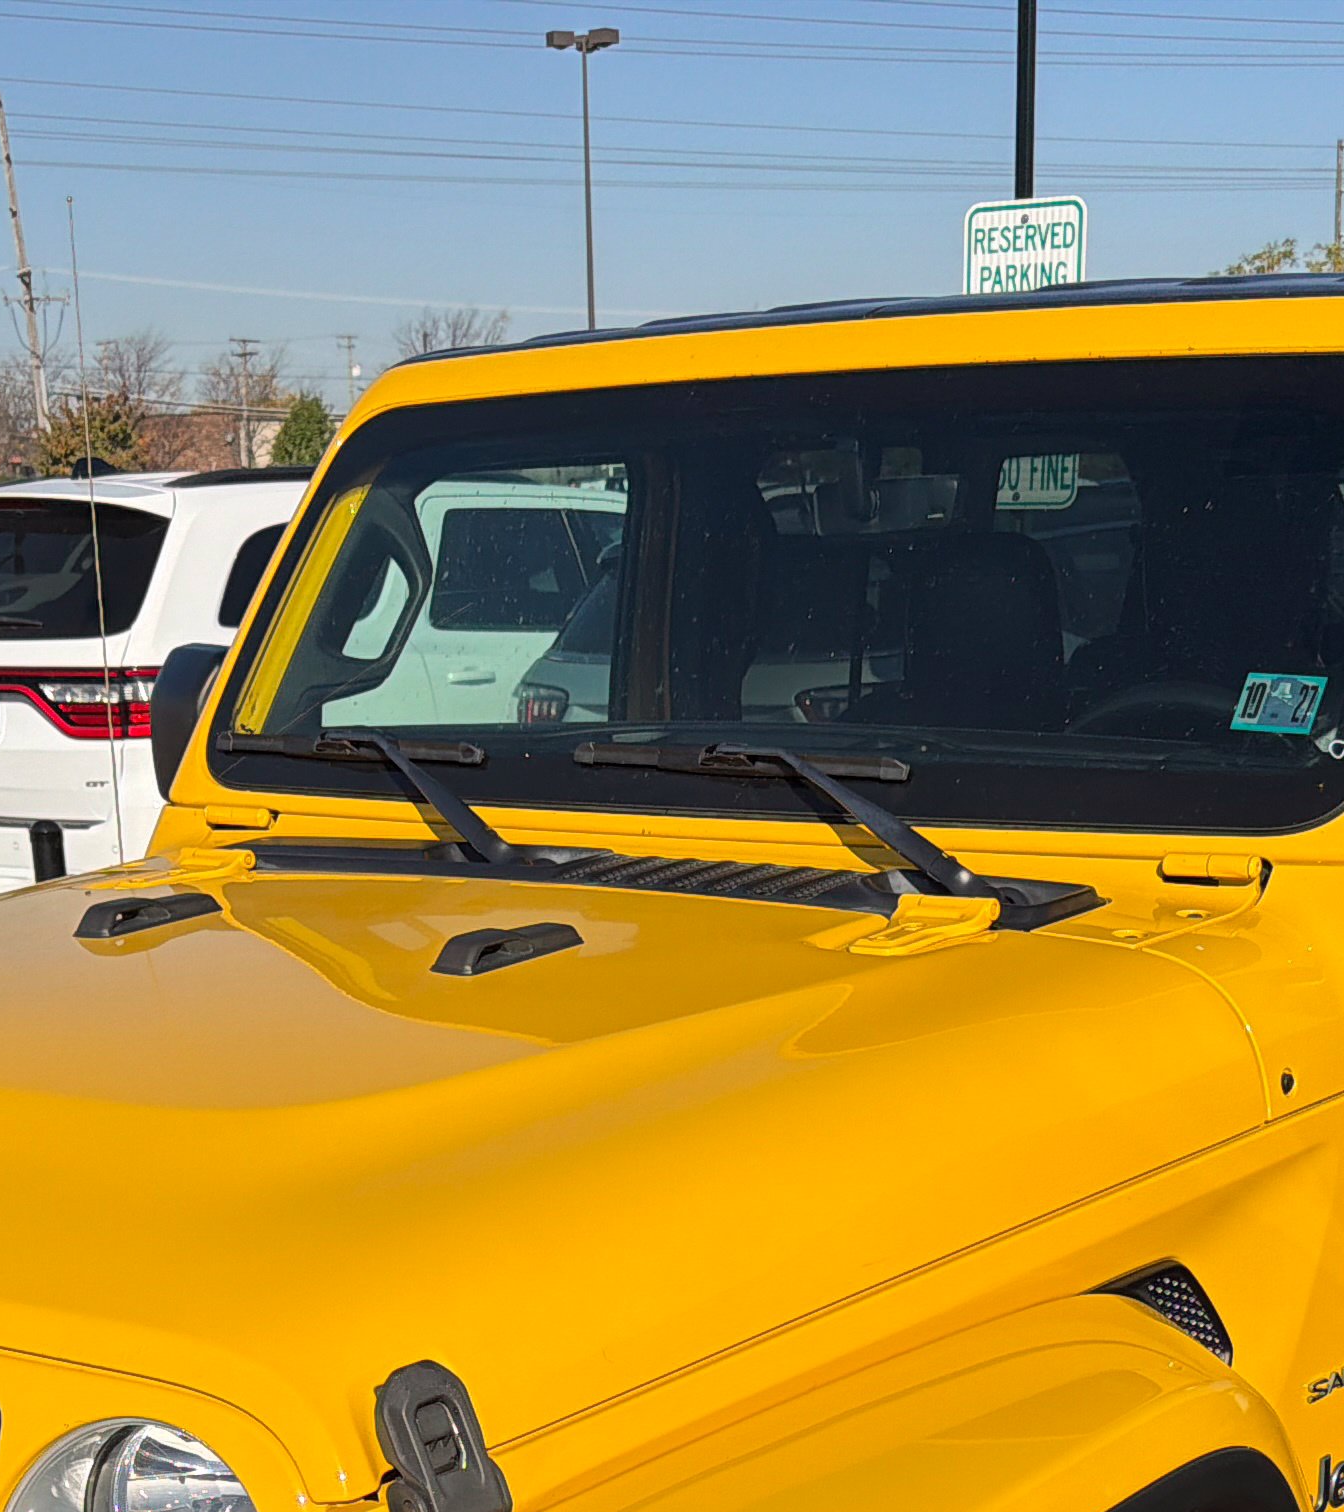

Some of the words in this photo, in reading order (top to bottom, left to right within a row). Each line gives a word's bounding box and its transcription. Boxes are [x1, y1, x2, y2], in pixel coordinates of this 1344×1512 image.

[973, 221, 1076, 255] RESERVED
[979, 261, 1068, 293] PARKING
[1029, 454, 1071, 491] FINE
